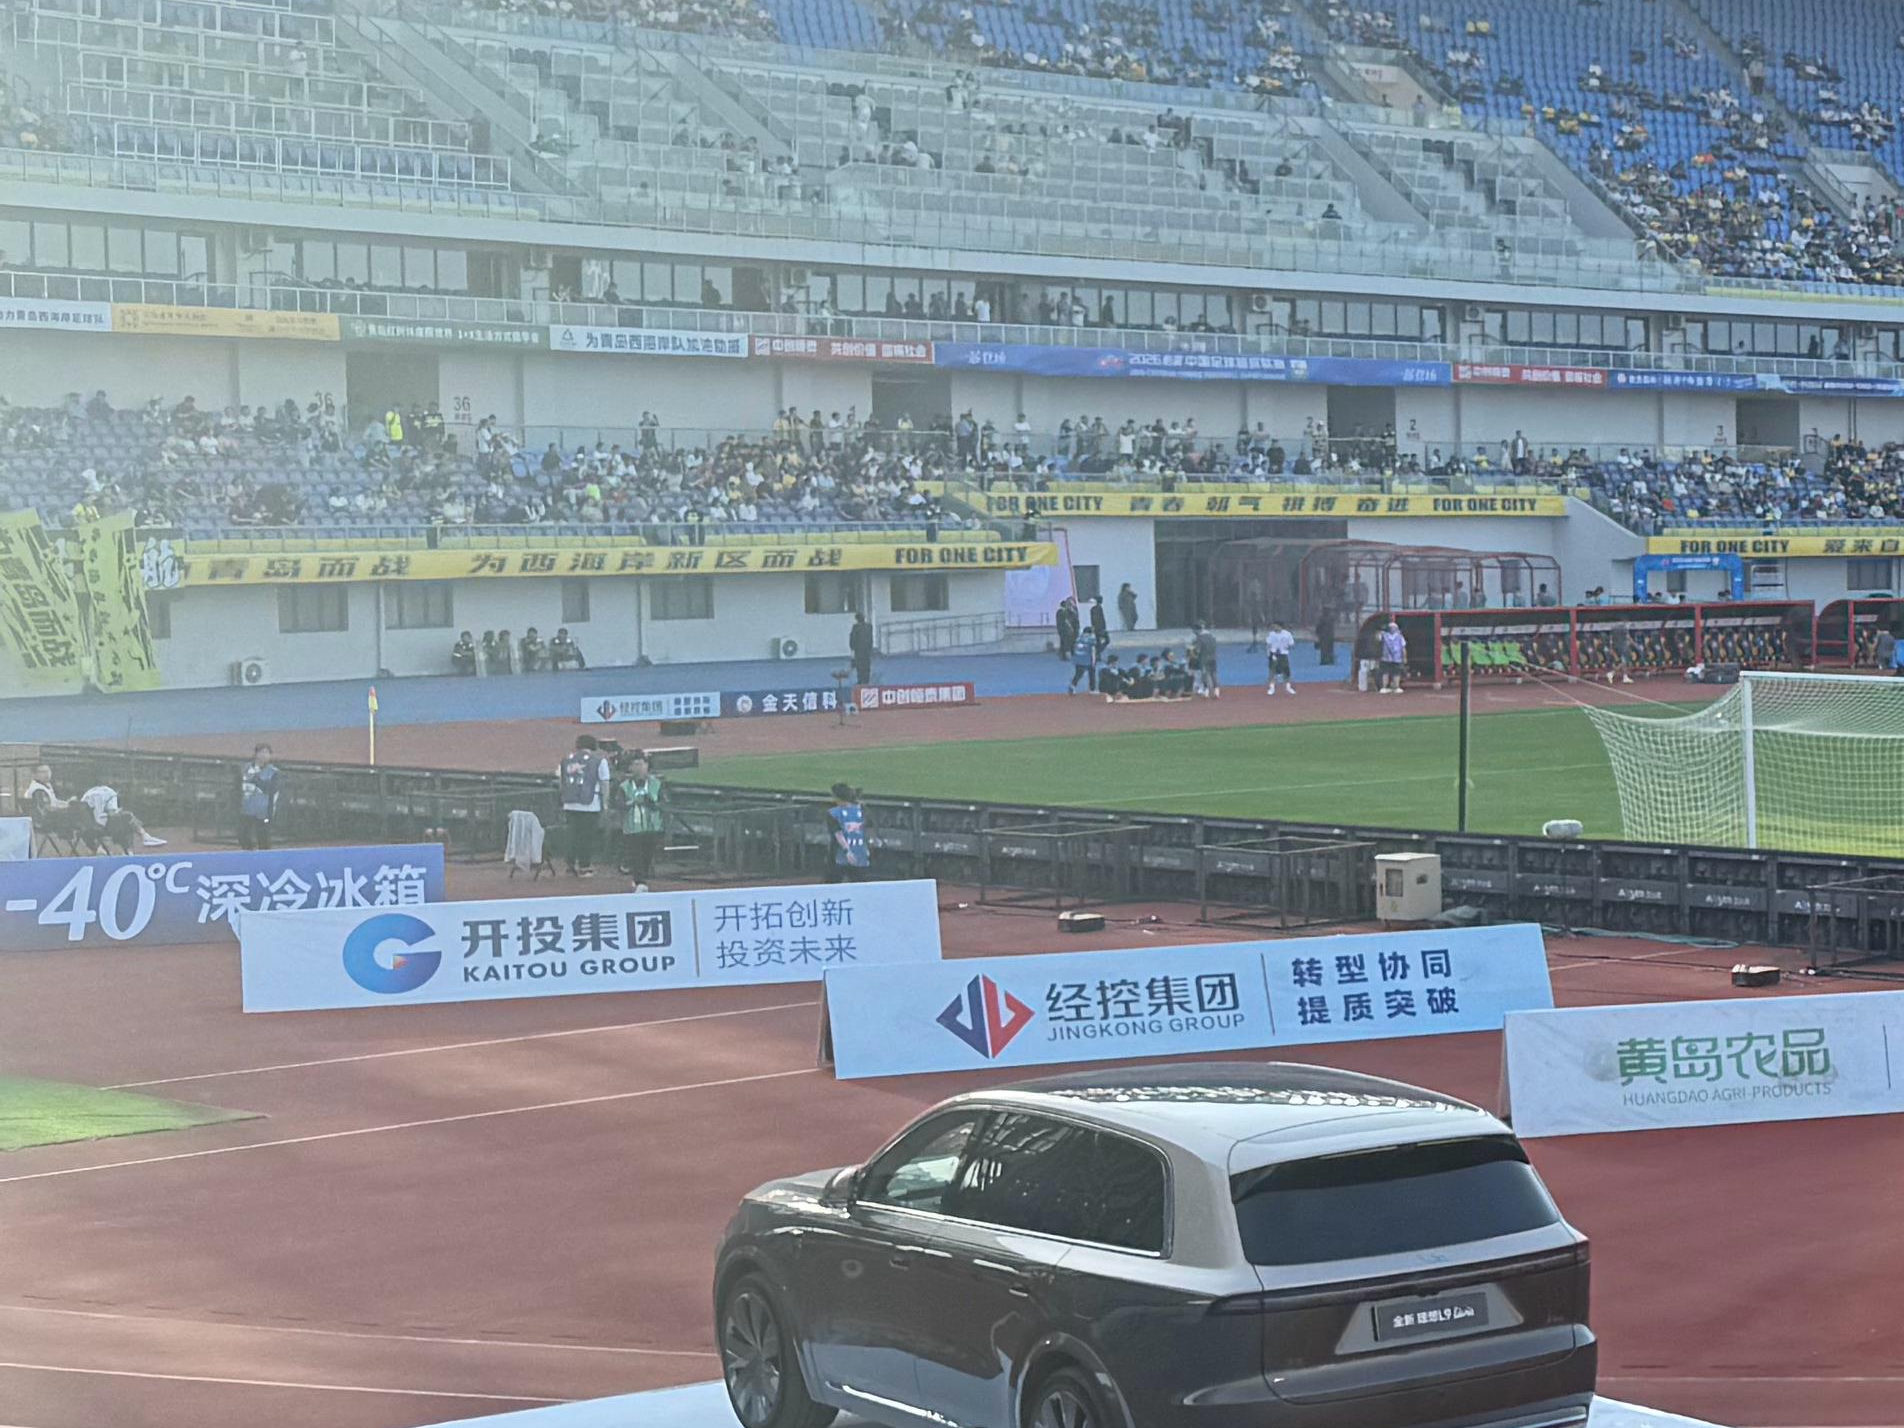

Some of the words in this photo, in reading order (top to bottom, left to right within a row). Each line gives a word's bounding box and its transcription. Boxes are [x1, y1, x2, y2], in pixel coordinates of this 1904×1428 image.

[453, 396, 471, 413] 36
[987, 496, 1018, 511] FOR
[1063, 495, 1104, 510] CITY
[1433, 497, 1465, 512] FOR
[1468, 497, 1498, 512] ONE
[1501, 497, 1537, 512] CITY
[469, 550, 843, 574] 为西海岸新区而战
[895, 547, 933, 564] FOR
[939, 546, 978, 563] ONE
[984, 545, 1028, 563] CITY
[1680, 539, 1711, 553] FOR
[1717, 539, 1748, 553] ONE
[1752, 539, 1790, 553] CITY
[761, 689, 838, 713] 金天信科
[196, 863, 429, 924] 深冷冰箱
[714, 897, 856, 933] 开拓创新
[461, 909, 674, 960] 开投集团
[716, 934, 859, 969] 投资未来
[462, 956, 568, 984] KAITOU
[578, 953, 677, 976] GROUP
[1291, 948, 1453, 989] 转型协同
[1046, 971, 1242, 1023] 经控集团
[1297, 987, 1461, 1028] 提质突破
[1047, 1018, 1165, 1043] JINGKONG
[1168, 1013, 1246, 1034] GROUP
[1616, 1027, 1832, 1087] 黄岛农品
[1621, 1086, 1710, 1107] HUANGDAO
[1711, 1080, 1833, 1103] AGRI-PRODUCTS
